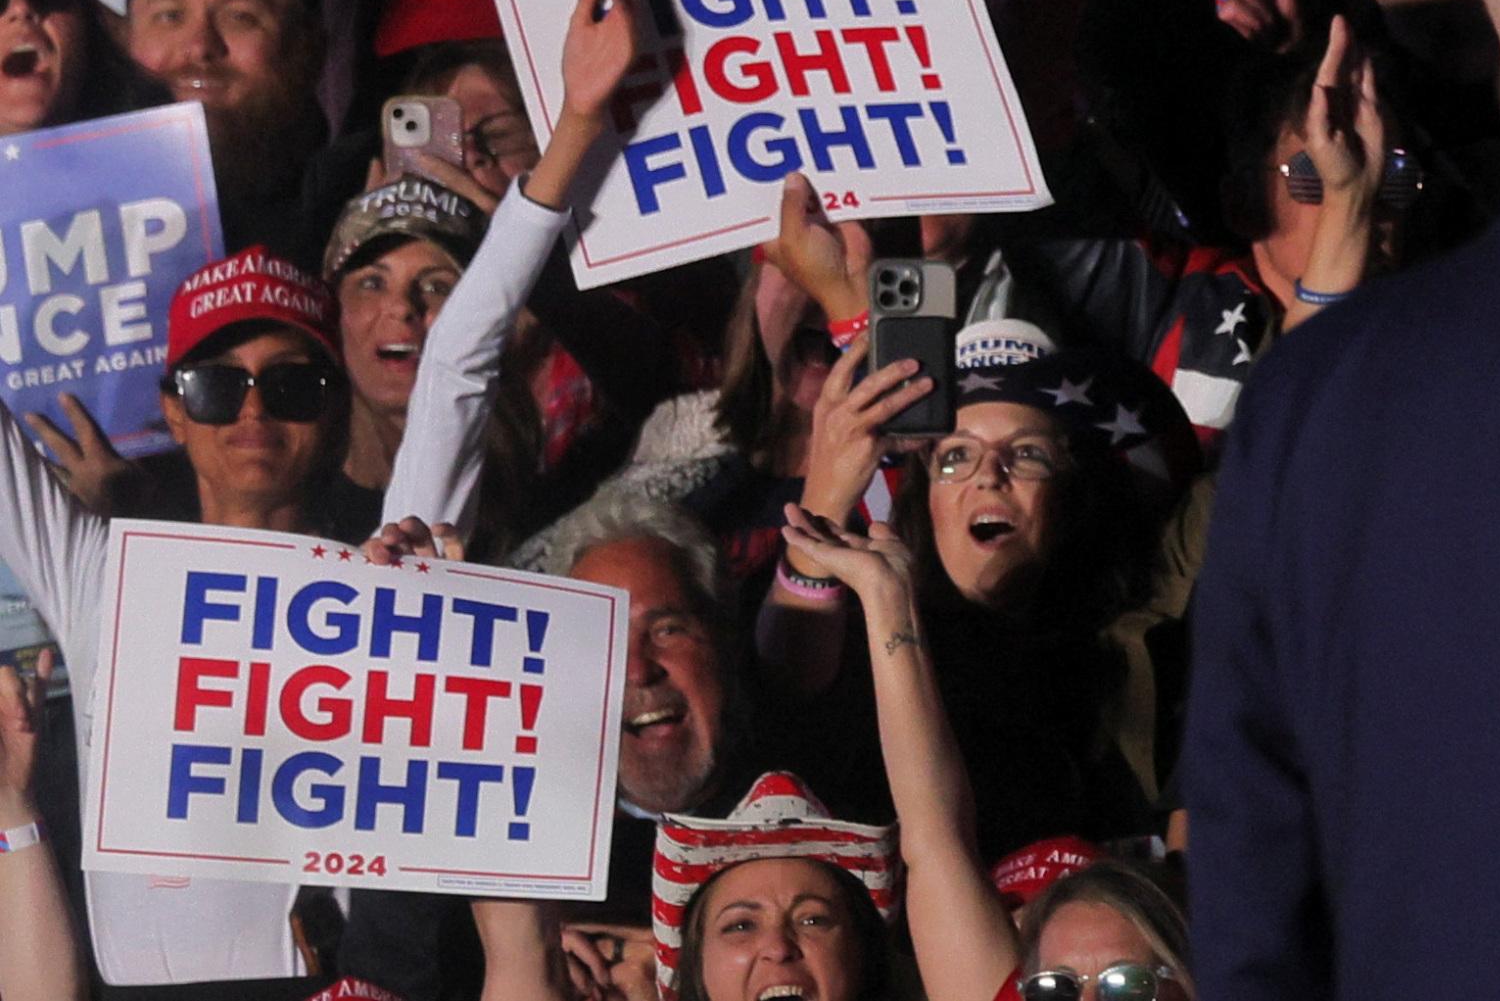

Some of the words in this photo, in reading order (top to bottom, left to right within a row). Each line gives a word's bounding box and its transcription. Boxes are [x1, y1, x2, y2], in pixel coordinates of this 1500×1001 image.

[624, 101, 968, 216] FIGHT!
[825, 190, 861, 211] 24
[181, 258, 240, 294] MAKE
[190, 281, 257, 319] GREAT
[6, 359, 85, 391] GREAT
[181, 571, 550, 674] FIGHT!
[174, 656, 543, 754] FIGHT!
[167, 744, 536, 841] FIGHT!
[303, 851, 388, 877] 2024
